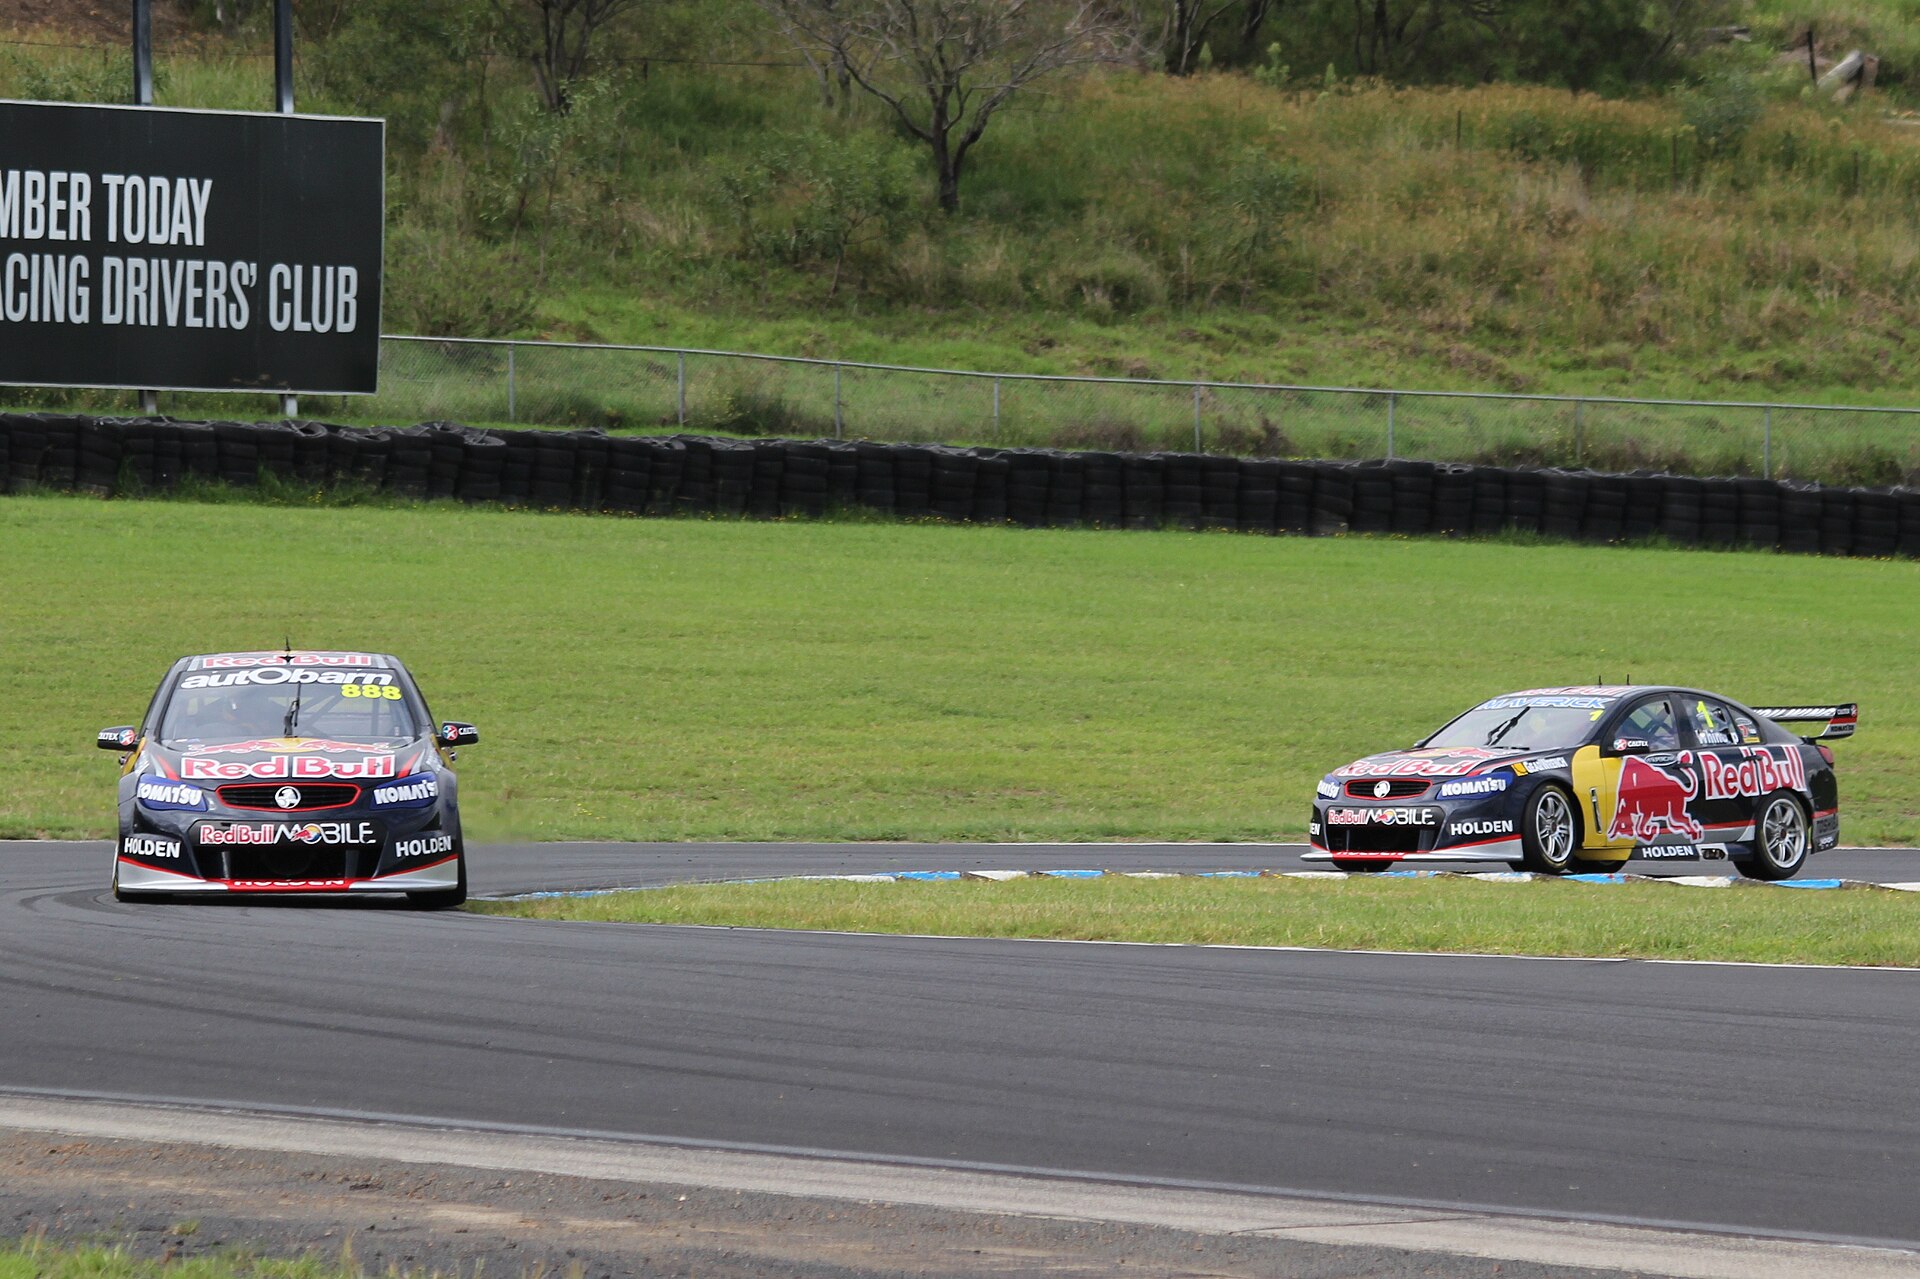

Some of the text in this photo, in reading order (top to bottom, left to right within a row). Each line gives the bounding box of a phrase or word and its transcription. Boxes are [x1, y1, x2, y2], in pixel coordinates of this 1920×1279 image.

[0, 170, 213, 246] MBER TODAY
[0, 252, 358, 333] CING DRIVERS' CLUB
[289, 655, 372, 666] Bull
[341, 684, 402, 700] 888
[1475, 696, 1617, 711] MAVERICK
[1589, 709, 1605, 722] 1
[1696, 700, 1714, 728] 1
[181, 754, 396, 779] Red Bull
[1335, 759, 1485, 776] Red Bull
[1697, 744, 1809, 800] Red Bull
[1441, 777, 1507, 798] KOMATSU
[273, 822, 376, 845] MOBILE
[1450, 820, 1514, 836] HOLDEN
[124, 838, 182, 858] HOLDEN
[395, 835, 452, 858] HOLDEN
[1642, 846, 1694, 858] HOLDEN
